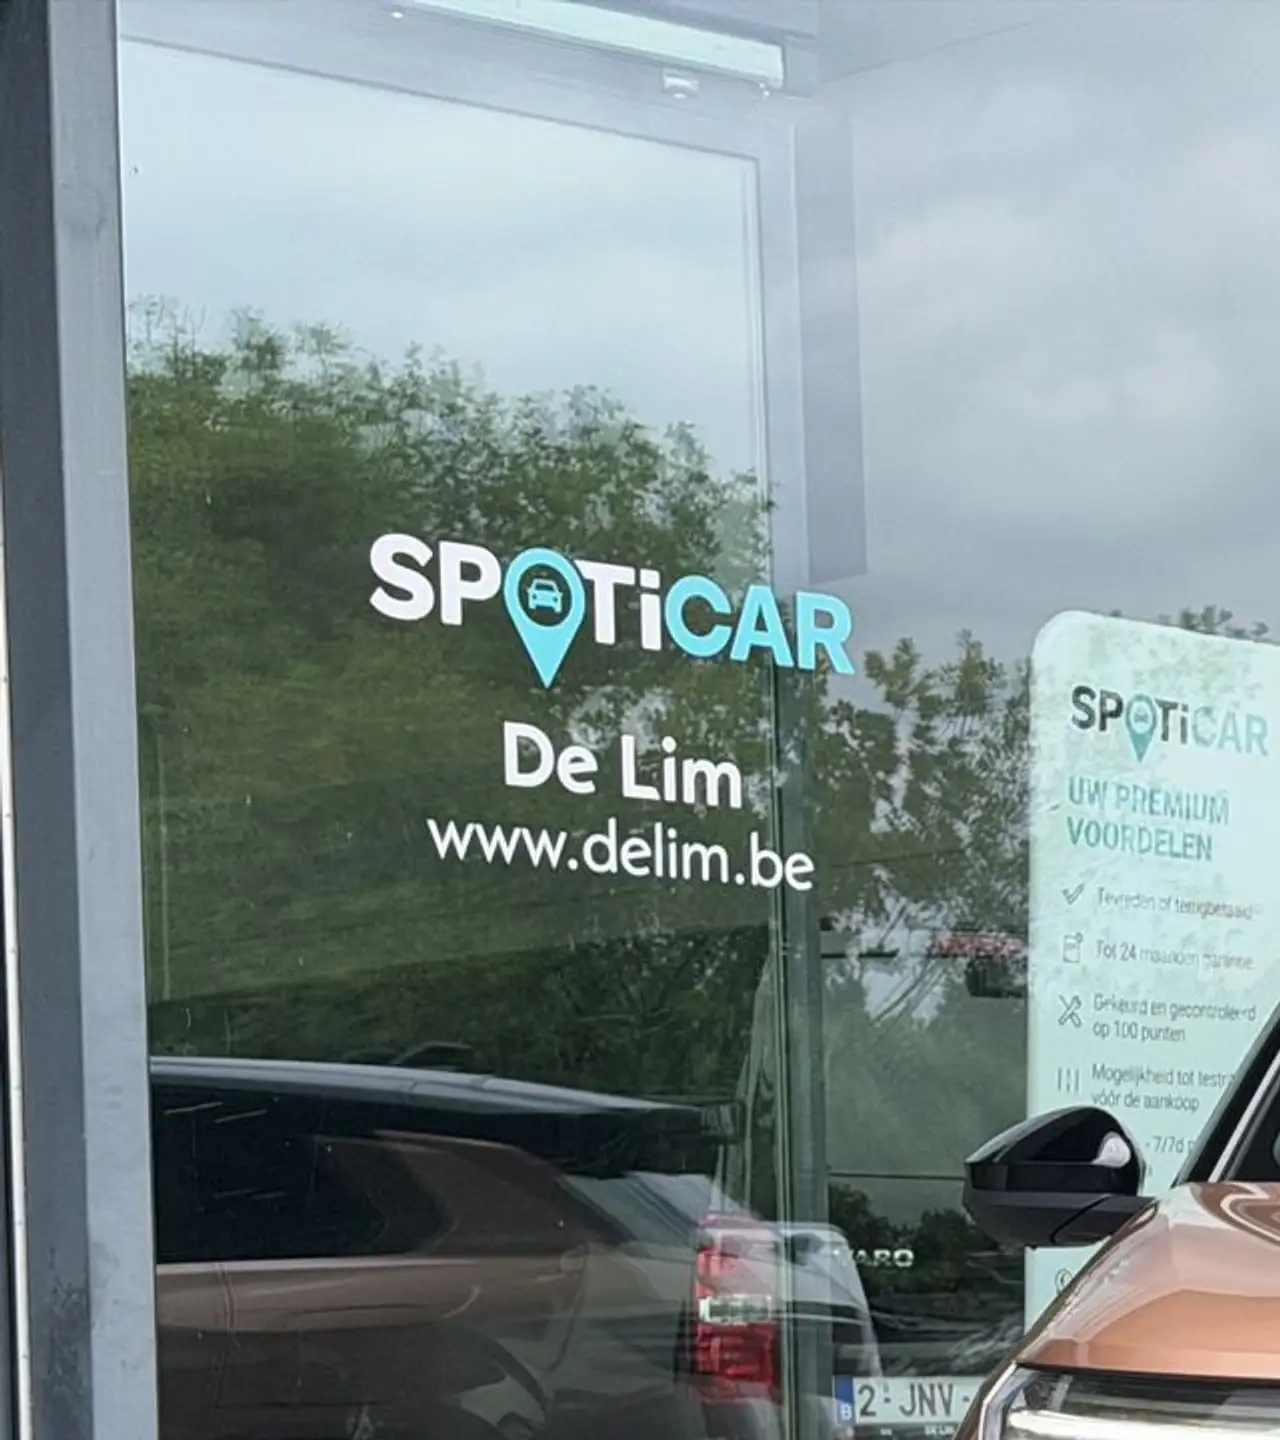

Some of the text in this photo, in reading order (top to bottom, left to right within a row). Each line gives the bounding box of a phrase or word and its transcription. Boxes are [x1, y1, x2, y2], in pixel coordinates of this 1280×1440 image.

[503, 721, 742, 808] De Lim
[1068, 776, 1230, 826] UW PREMIUM
[427, 818, 815, 890] www.delim.be
[1067, 816, 1213, 861] VOORDELEN
[1097, 940, 1116, 960] Tot
[1120, 942, 1136, 961] 24
[1092, 1020, 1186, 1042] op 100 punten
[1176, 1070, 1195, 1086] tot
[1124, 1091, 1141, 1109] de
